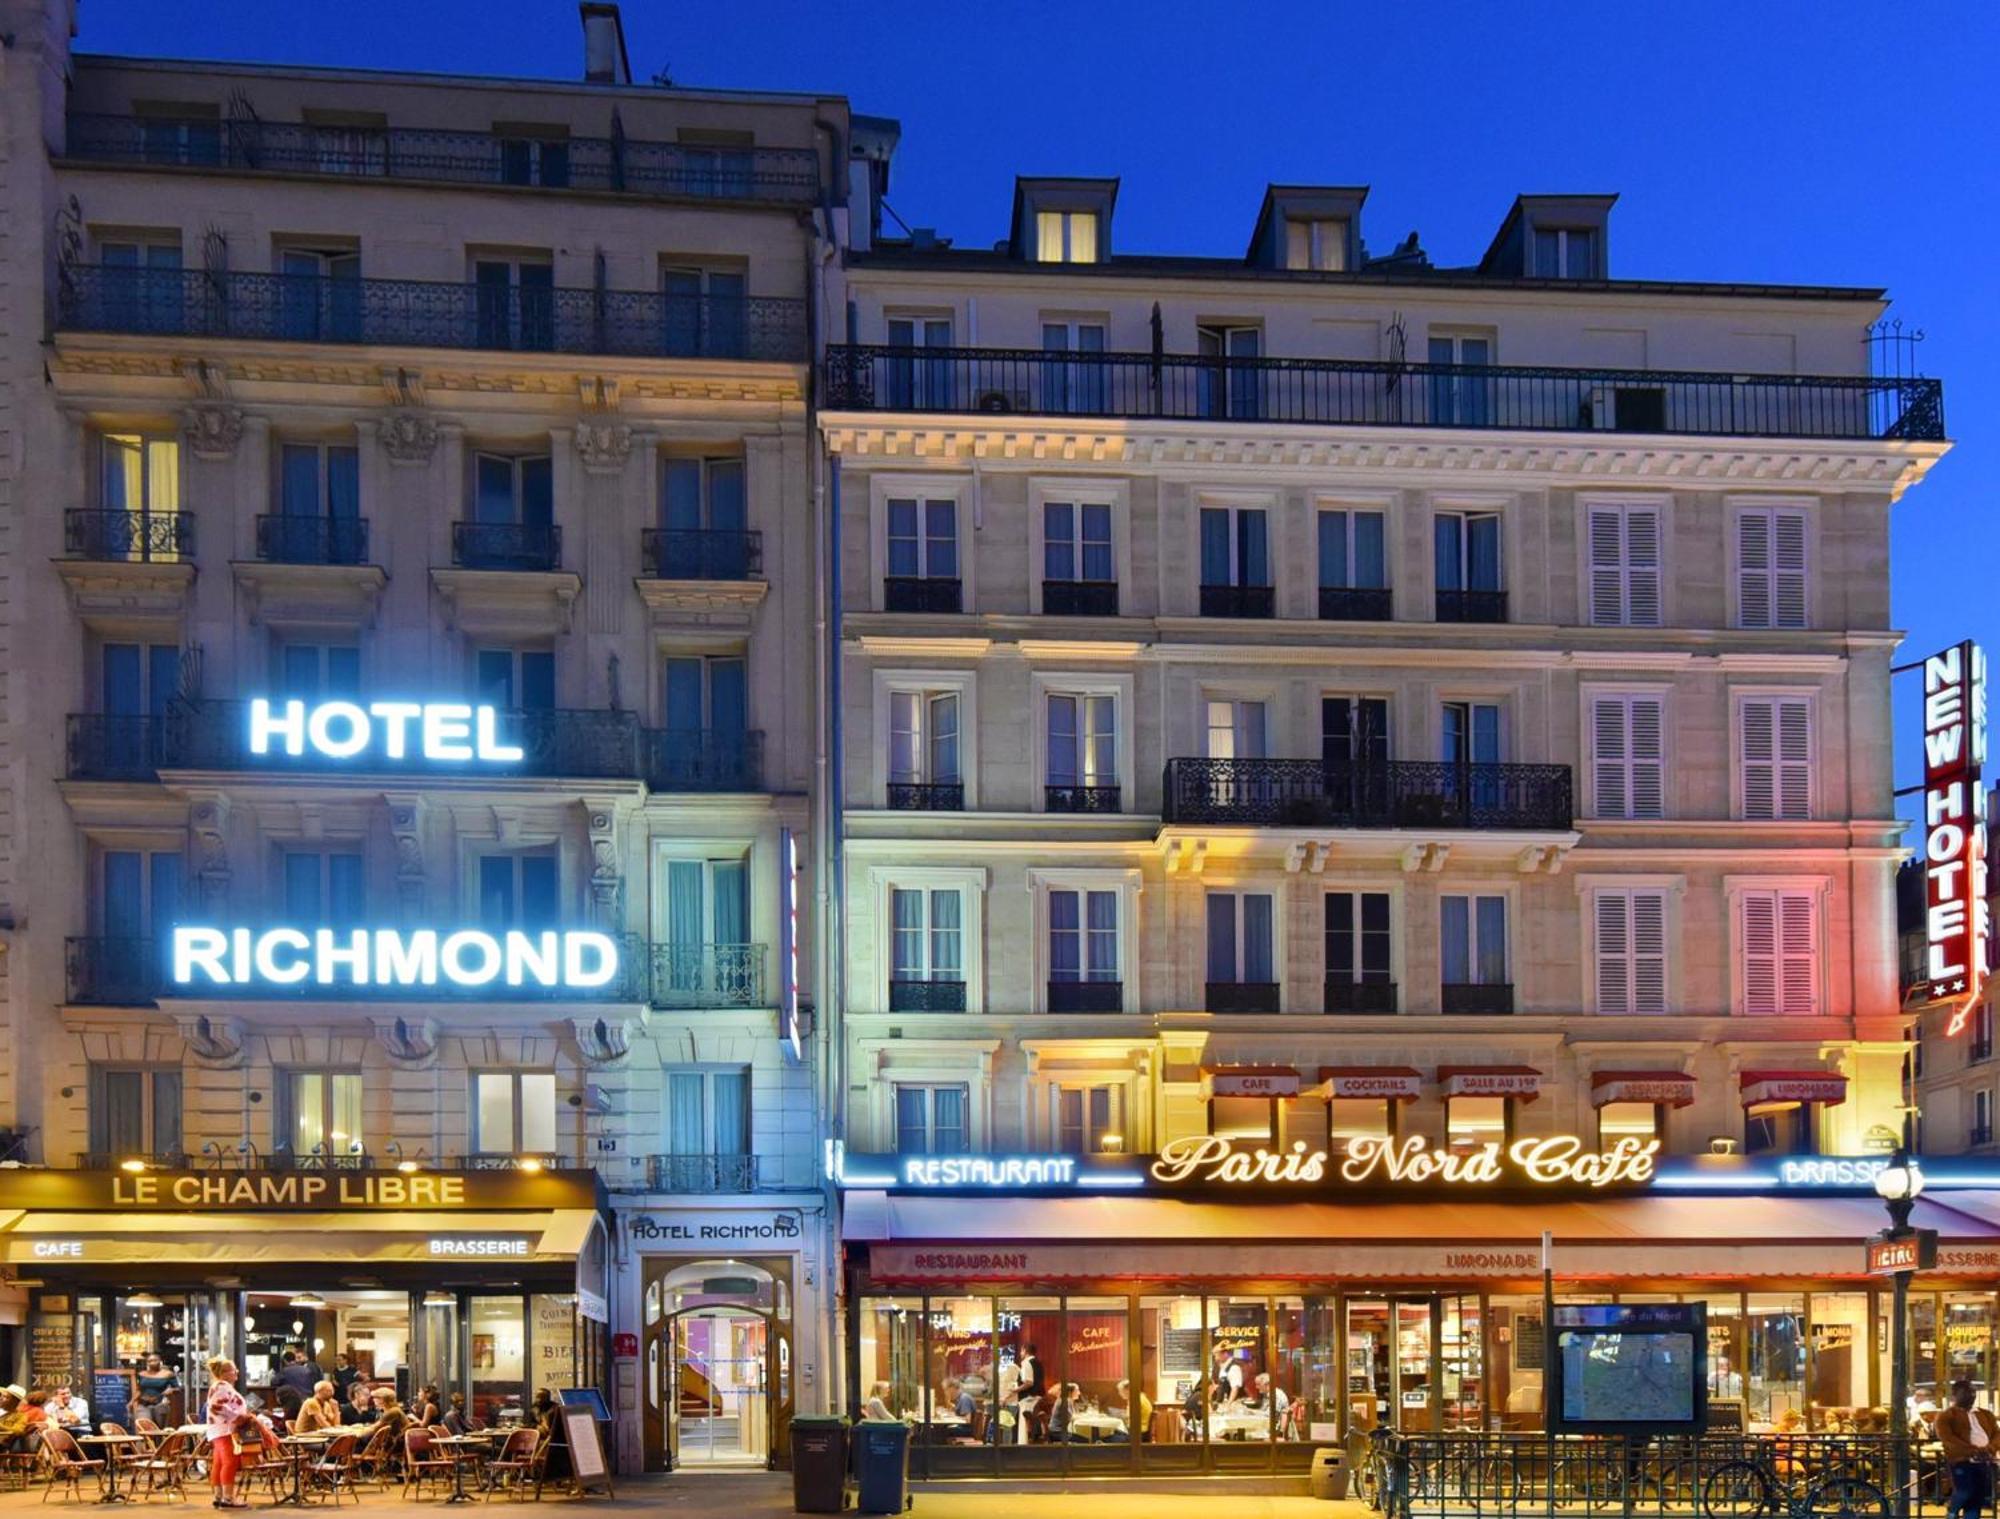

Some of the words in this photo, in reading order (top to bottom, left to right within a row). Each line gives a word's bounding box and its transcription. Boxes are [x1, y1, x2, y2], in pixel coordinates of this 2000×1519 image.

[1925, 646, 1962, 768] NEW
[250, 698, 524, 761] HOTEL
[1926, 780, 1964, 981] HOTEL
[173, 927, 618, 987] RICHMOND
[1242, 1078, 1271, 1089] CAFE
[1343, 1079, 1407, 1090] COCKTAILS
[1498, 1077, 1514, 1088] AU
[1151, 1134, 1327, 1183] Paris
[1342, 1134, 1502, 1183] Nord
[1509, 1135, 1661, 1187] Café
[906, 1158, 1075, 1184] RESTAURANT
[1785, 1160, 1918, 1184] BRASSE
[112, 1176, 158, 1204] LE
[173, 1176, 327, 1204] CHAMP
[339, 1176, 465, 1204] LIBRE
[633, 1225, 694, 1239] HOTEL
[700, 1225, 800, 1239] RICHMOND
[34, 1242, 83, 1256] CAFE
[430, 1240, 528, 1254] BRASSERIE
[914, 1253, 1028, 1269] RESTAURANT
[1446, 1253, 1537, 1268] LIMONADE
[1655, 1311, 1682, 1321] Nord
[1082, 1327, 1111, 1338] CAFE
[1217, 1326, 1260, 1337] SERVICE
